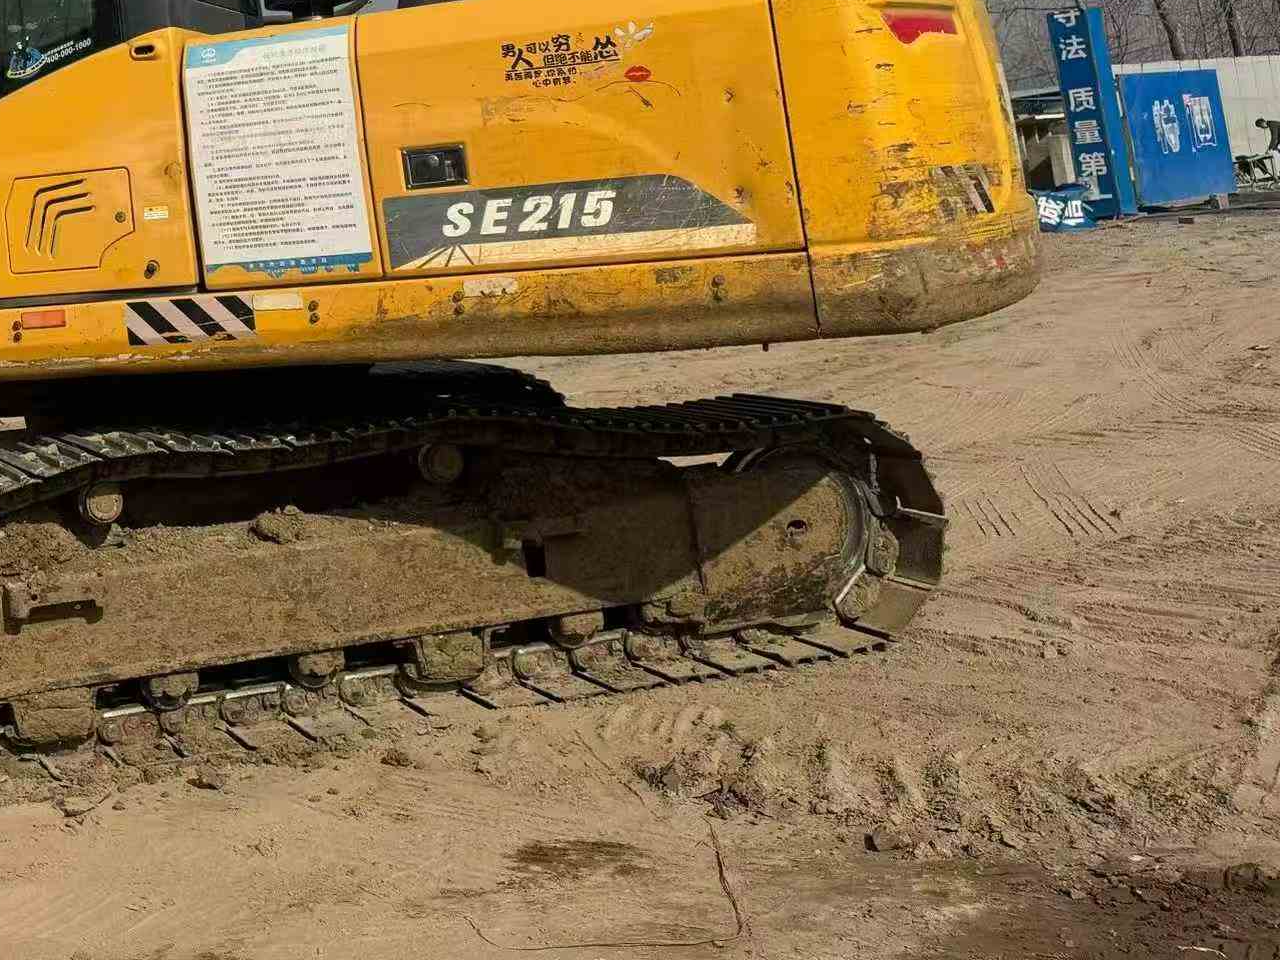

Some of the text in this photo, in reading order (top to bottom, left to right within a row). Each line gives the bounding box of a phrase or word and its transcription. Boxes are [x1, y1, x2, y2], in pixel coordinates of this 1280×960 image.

[501, 33, 571, 70] 男人可以穷
